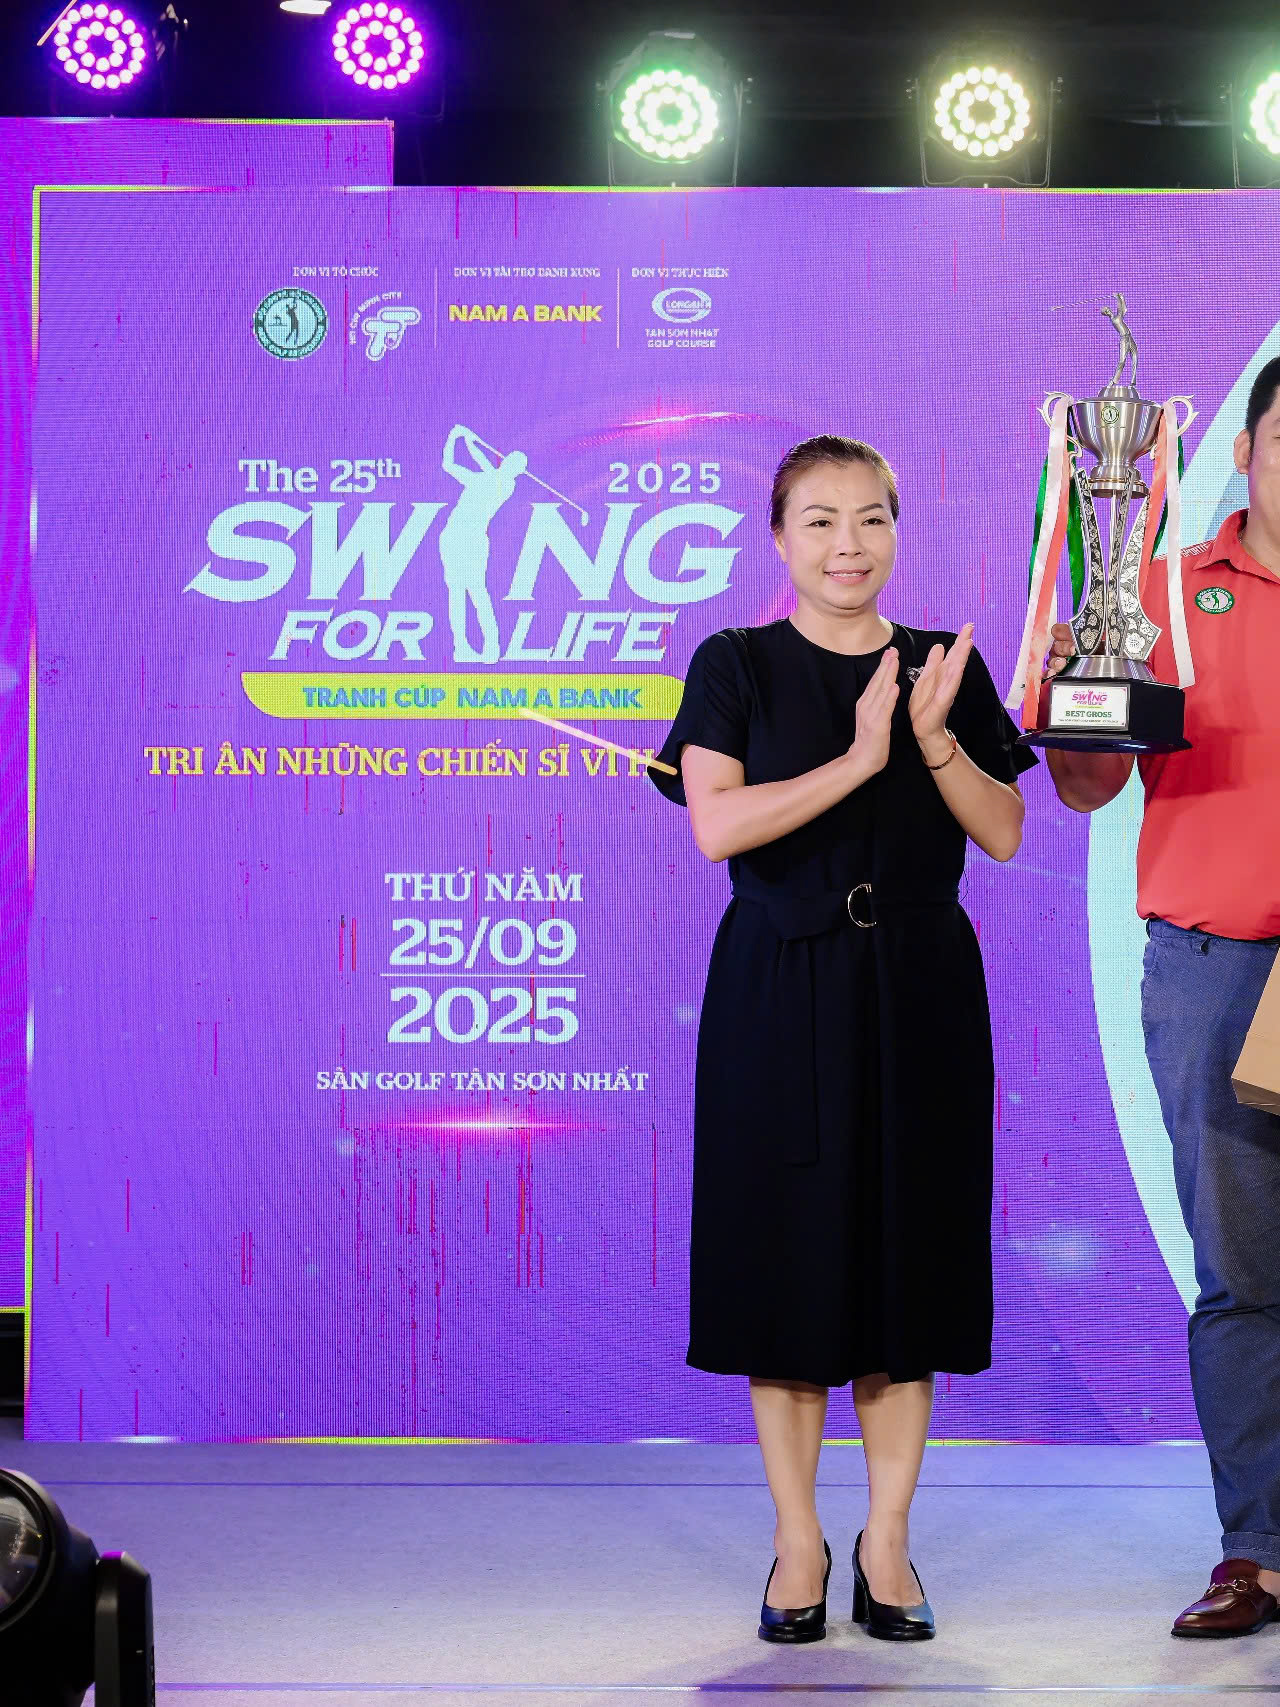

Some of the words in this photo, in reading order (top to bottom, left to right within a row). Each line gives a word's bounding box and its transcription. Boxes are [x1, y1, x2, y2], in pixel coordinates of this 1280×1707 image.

[448, 304, 508, 322] NAM
[512, 304, 529, 322] A
[533, 304, 603, 322] BANK
[648, 339, 673, 348] GOLF
[676, 339, 716, 348] COURSE
[238, 458, 319, 493] The
[329, 457, 401, 494] 25th
[606, 462, 722, 494] 2025
[267, 607, 434, 661] FOR
[499, 608, 680, 662] LIFE
[302, 686, 386, 708] TRANH
[394, 683, 447, 708] CÚP
[457, 687, 528, 709] NAM
[533, 687, 553, 708] A
[558, 687, 643, 709] BANK
[1065, 710, 1085, 718] BEST
[144, 746, 204, 776] TRI
[213, 740, 267, 776] ÂN
[276, 742, 408, 776] NHỮNG
[417, 738, 529, 777] CHIẾN
[538, 743, 570, 777] SĨ
[384, 866, 476, 902] THỨ
[485, 866, 584, 902] NĂM
[388, 917, 578, 969] 25/09
[387, 986, 580, 1045] 2025
[316, 1065, 369, 1091] SÂN
[375, 1071, 445, 1091] GOLF
[450, 1067, 505, 1091] TÂN
[512, 1070, 566, 1091] SƠN
[571, 1064, 649, 1091] NHẤT
